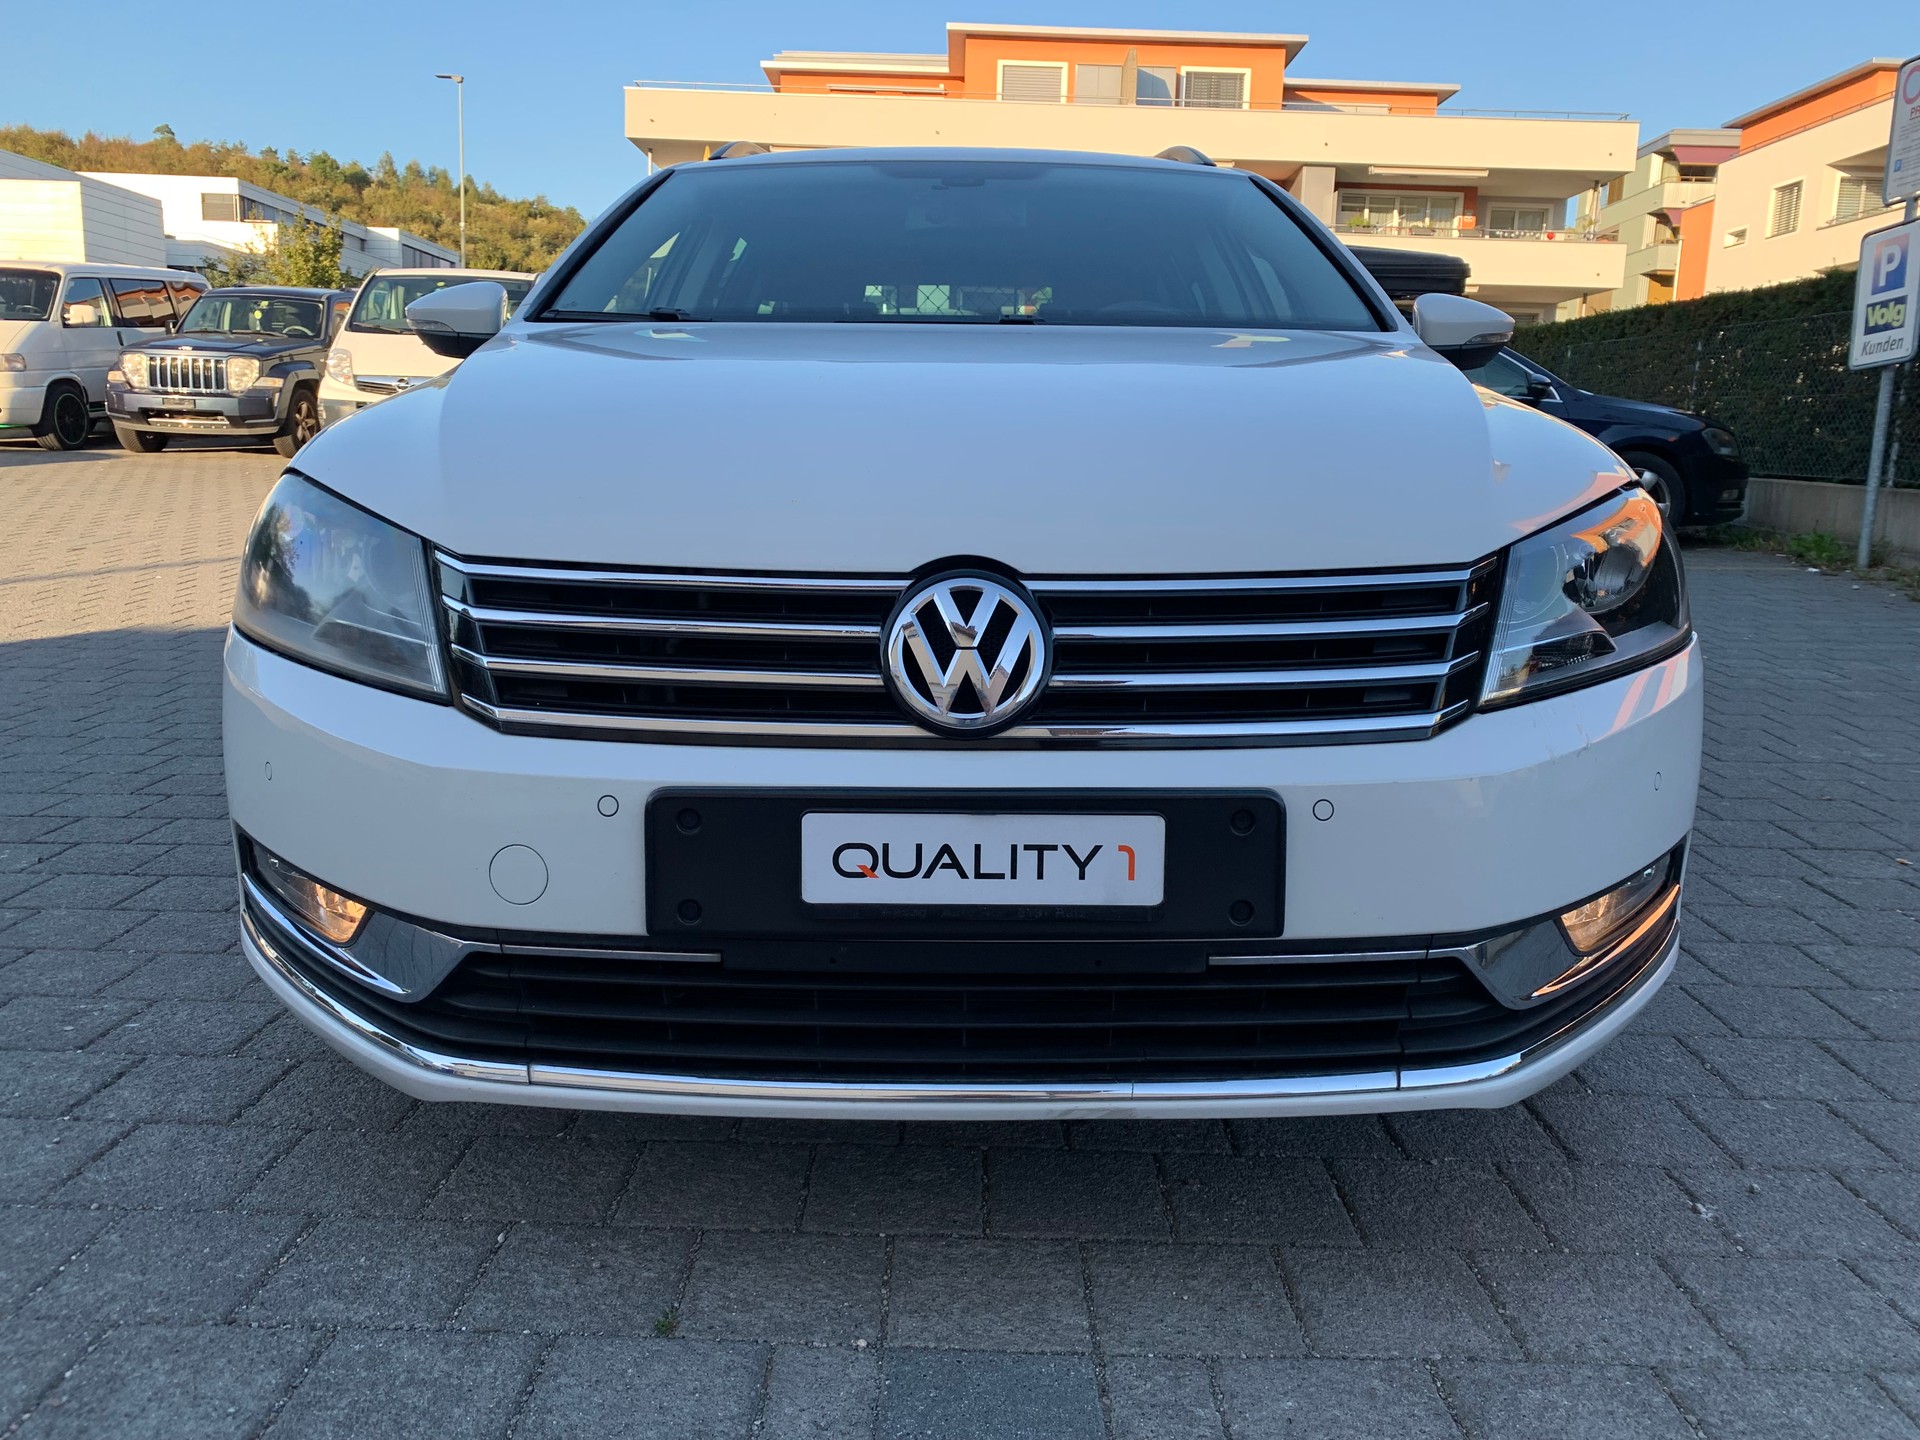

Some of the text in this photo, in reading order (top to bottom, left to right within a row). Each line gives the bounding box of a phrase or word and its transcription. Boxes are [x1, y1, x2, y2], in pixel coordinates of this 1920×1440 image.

[1878, 244, 1902, 287] P
[1867, 301, 1906, 327] Volg
[1861, 335, 1904, 357] Kunden
[831, 842, 1103, 881] QUALITY
